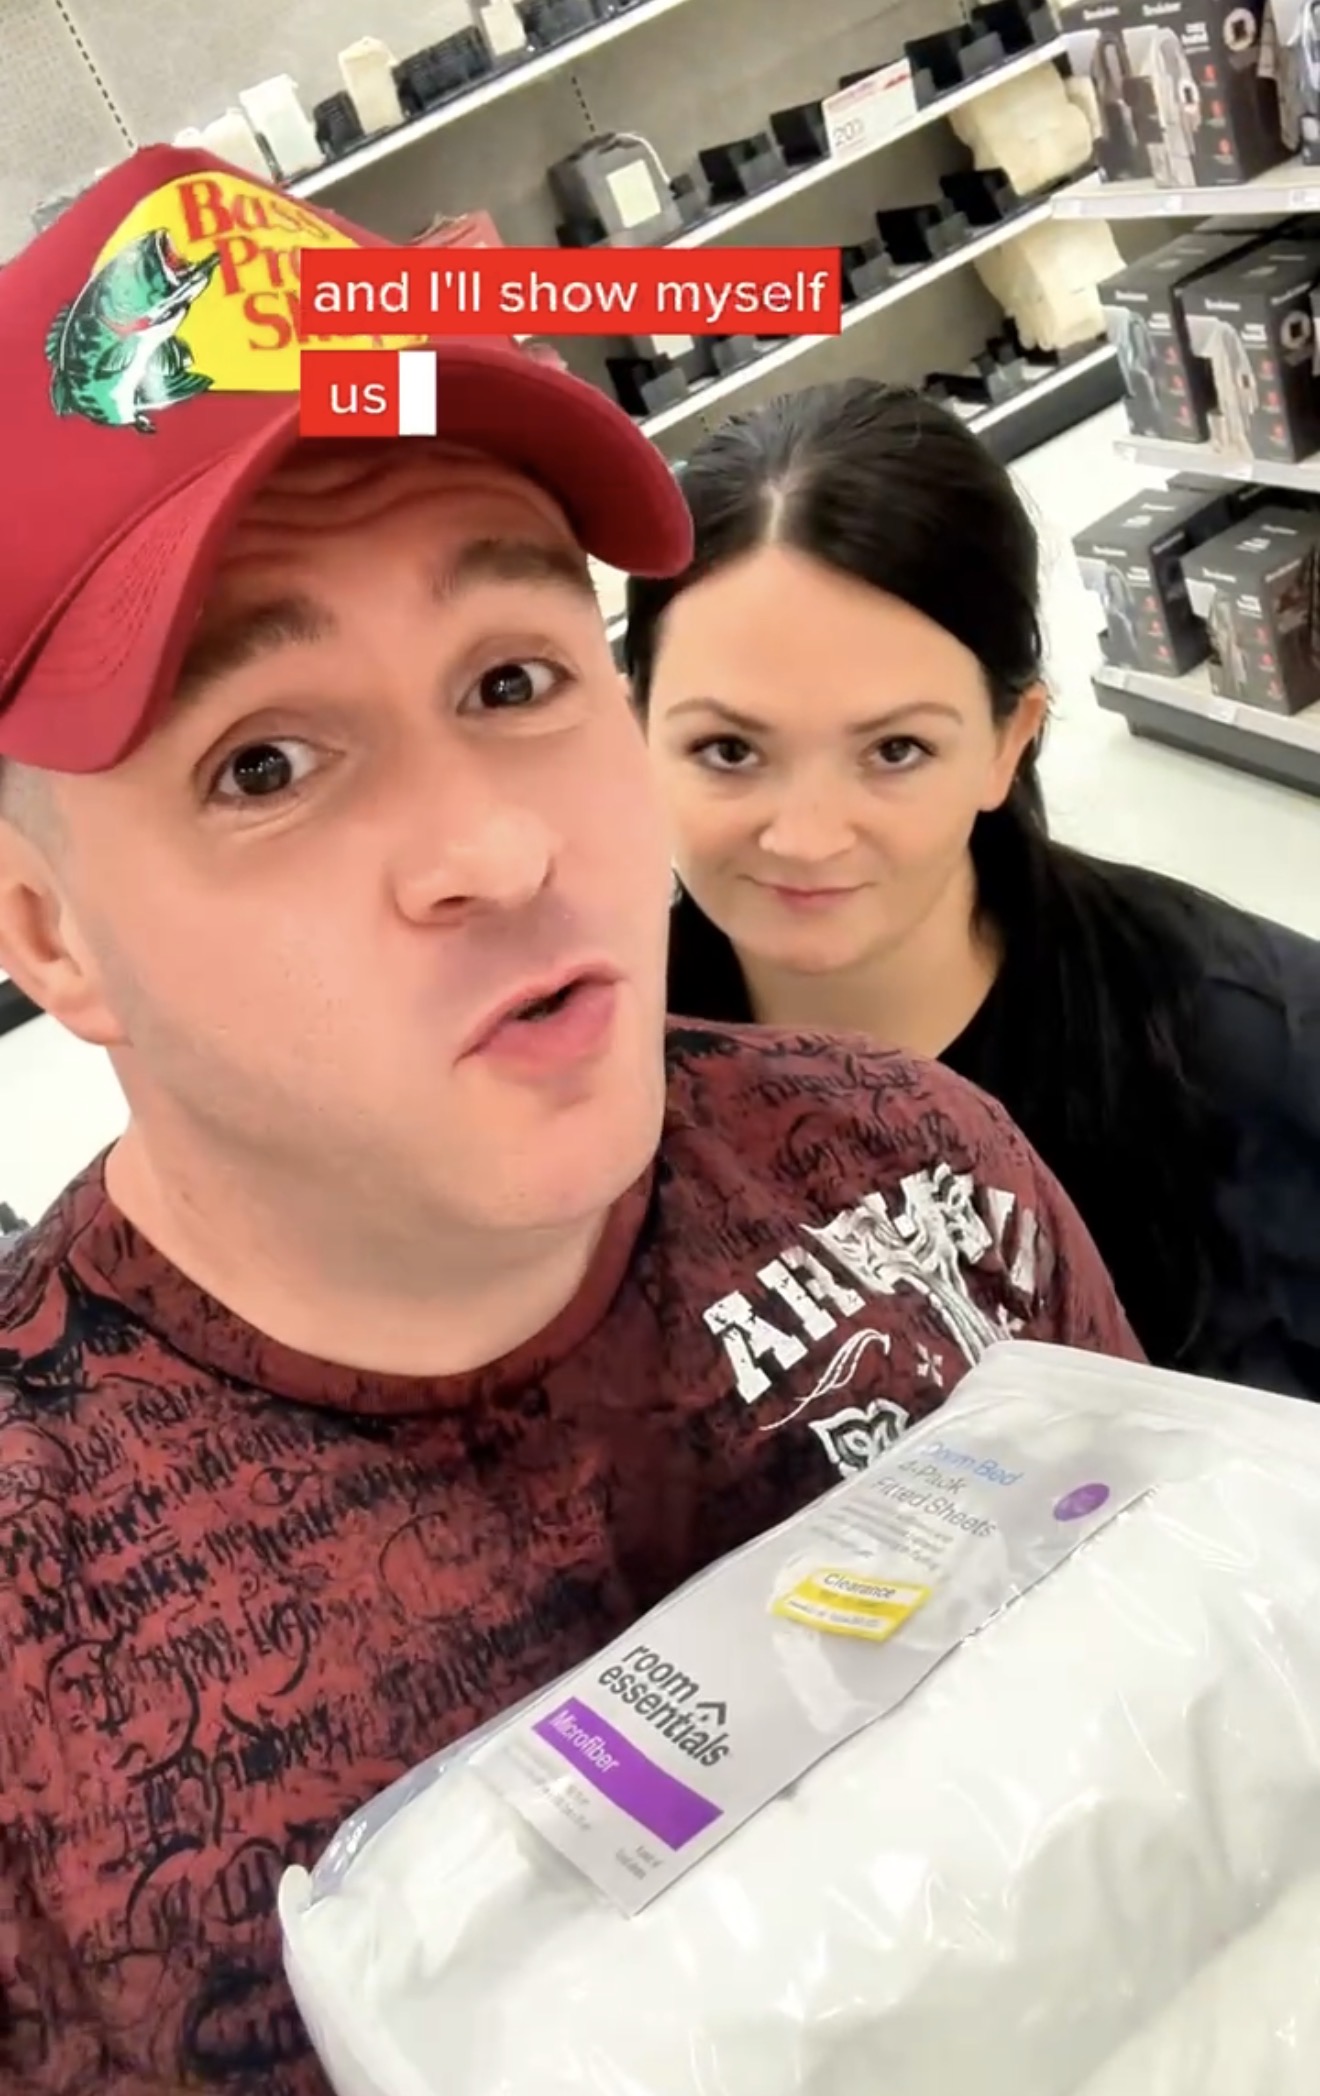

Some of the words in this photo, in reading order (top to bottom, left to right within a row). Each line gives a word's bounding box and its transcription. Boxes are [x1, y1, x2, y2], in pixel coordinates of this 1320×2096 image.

[176, 179, 331, 243] Bass
[974, 1459, 1025, 1486] Bed
[923, 1496, 996, 1537] Sheets
[823, 1572, 896, 1599] Clearance
[621, 1645, 700, 1703] room
[547, 1709, 621, 1774] Microfiber
[598, 1664, 730, 1767] essentials
